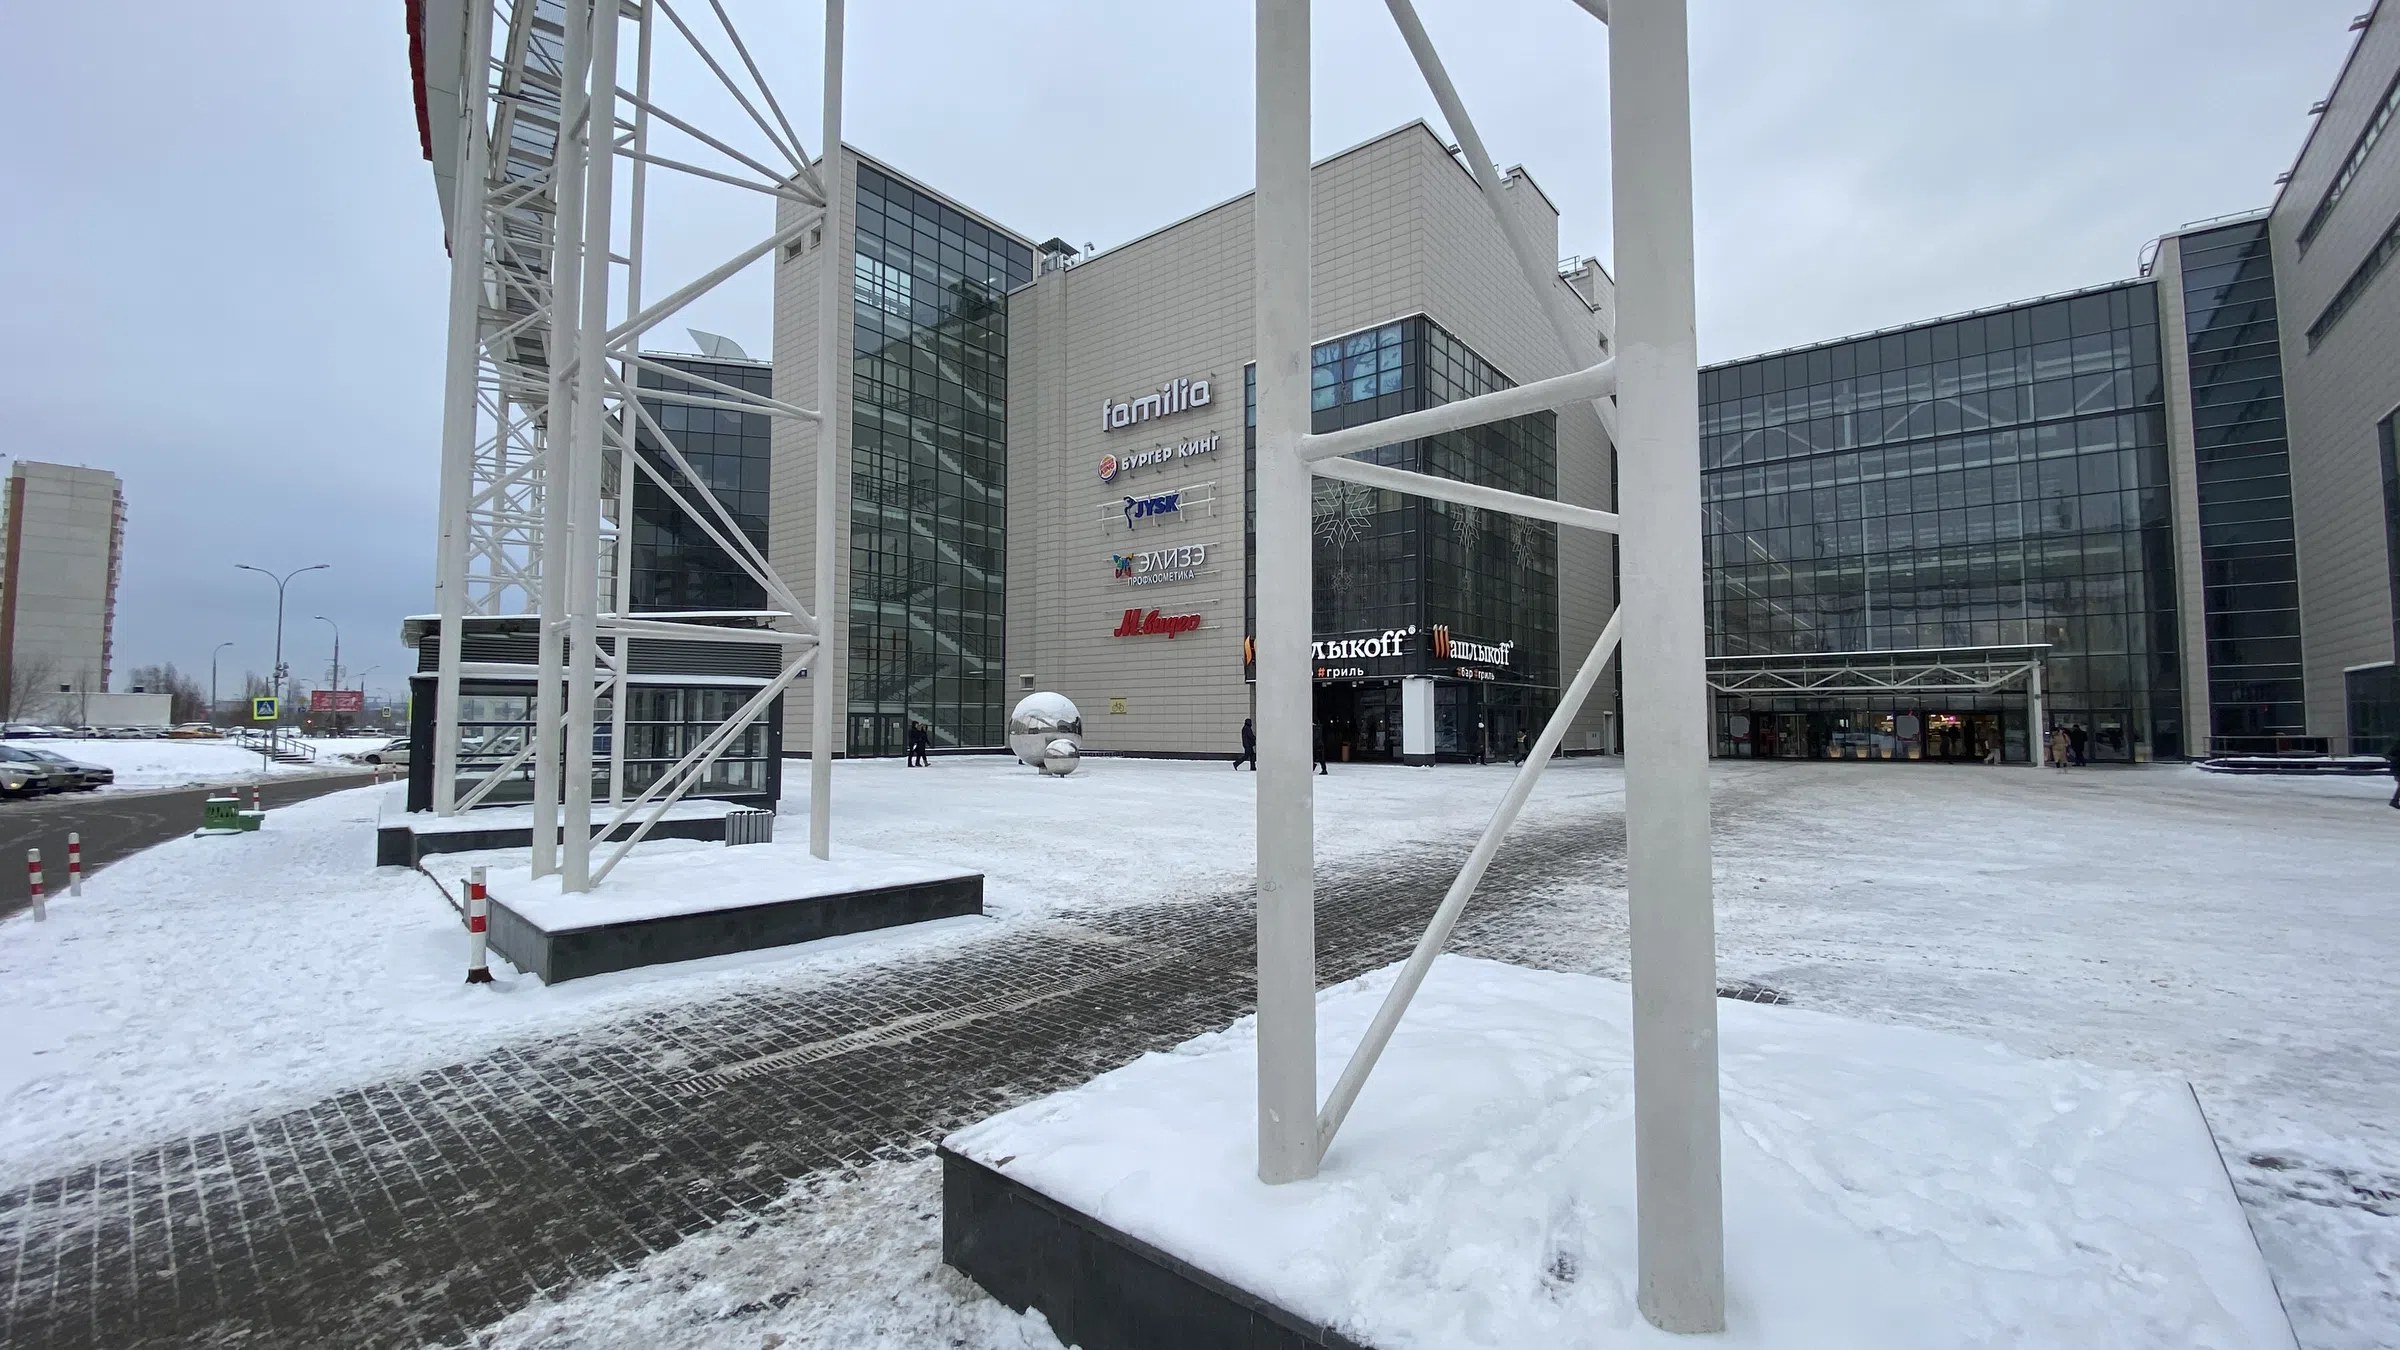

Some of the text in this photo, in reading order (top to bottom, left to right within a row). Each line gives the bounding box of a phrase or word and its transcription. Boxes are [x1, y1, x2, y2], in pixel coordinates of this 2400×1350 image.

[1103, 378, 1211, 432] familia
[1121, 447, 1173, 471] БУРГЕР
[1178, 435, 1221, 458] КИНГ
[1134, 494, 1180, 518] JYSK
[1138, 544, 1205, 573] ЭЛИЗЭ
[1127, 569, 1195, 587] ПРОФКОСМЕТИКА
